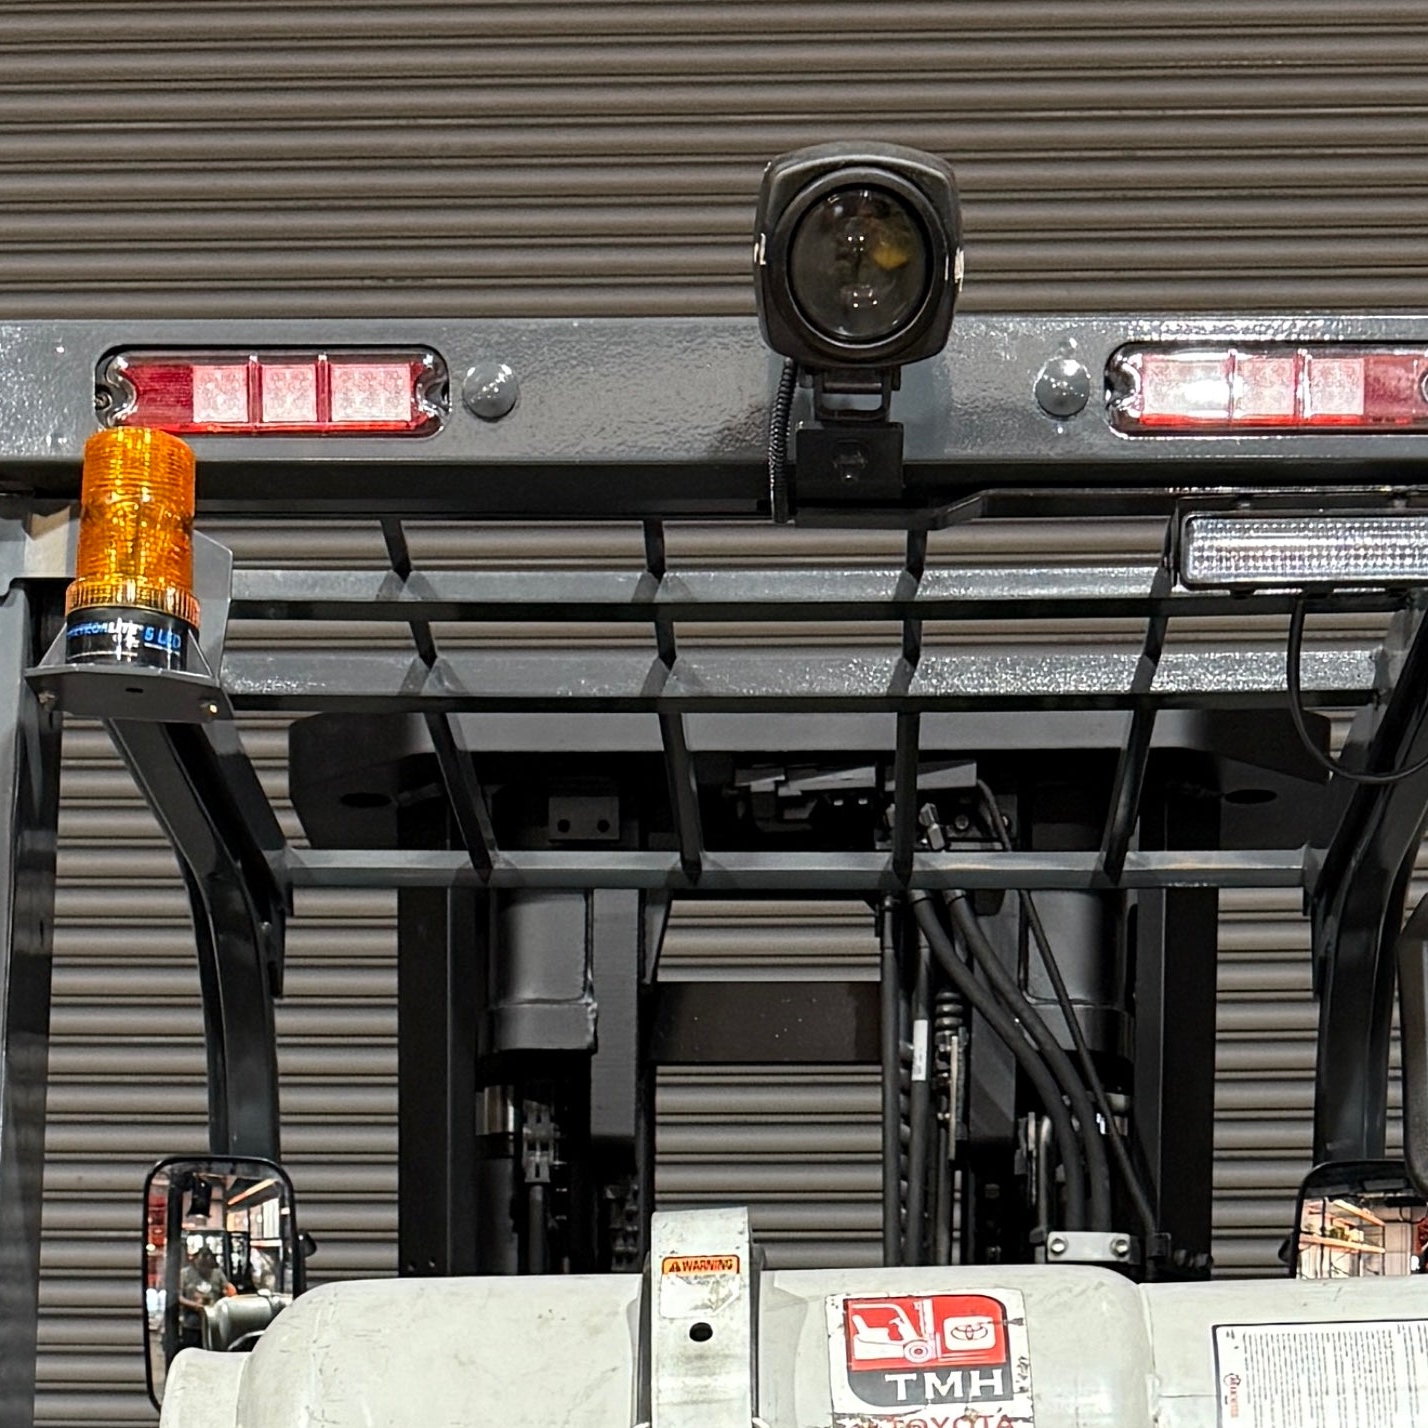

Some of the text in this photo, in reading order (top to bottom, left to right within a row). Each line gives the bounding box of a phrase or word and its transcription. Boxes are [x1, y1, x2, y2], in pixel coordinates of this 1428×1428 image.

[157, 628, 181, 649] LED
[682, 1259, 733, 1272] WARNING
[884, 1369, 1004, 1401] TMH
